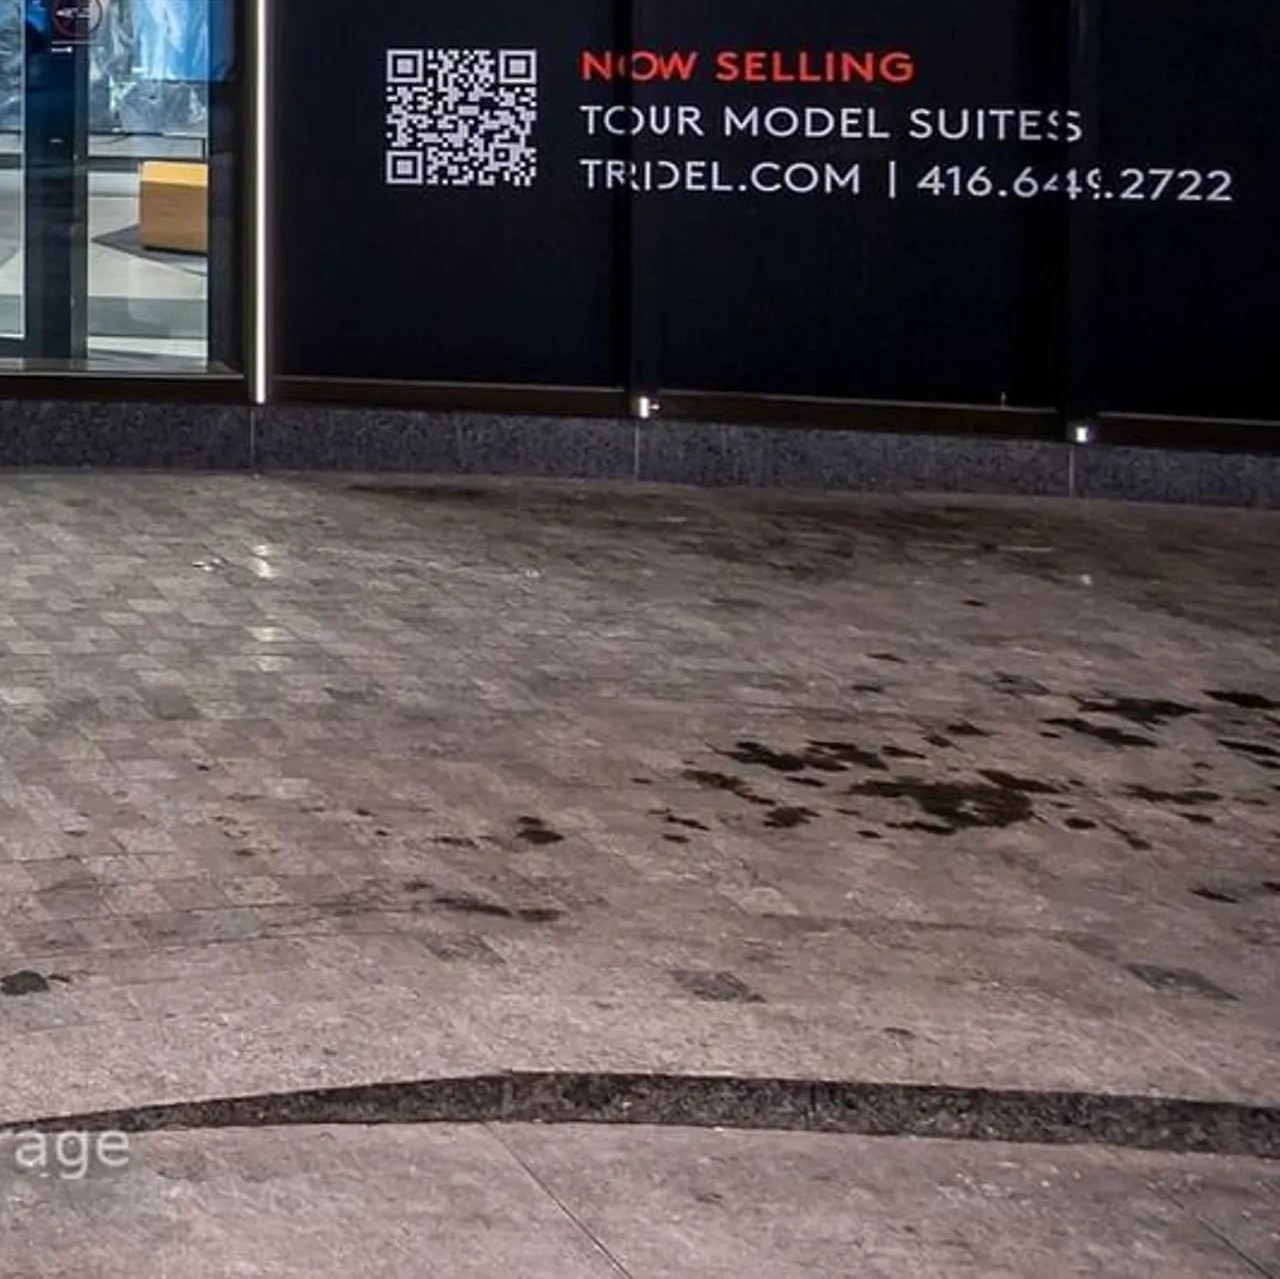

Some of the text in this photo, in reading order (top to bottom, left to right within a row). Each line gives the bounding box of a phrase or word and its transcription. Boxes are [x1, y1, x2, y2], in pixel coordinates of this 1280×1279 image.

[582, 50, 914, 82] NOW SELLING
[579, 104, 1083, 142] TOUR MODEL SUITES
[579, 159, 861, 194] TRIDEL.COM
